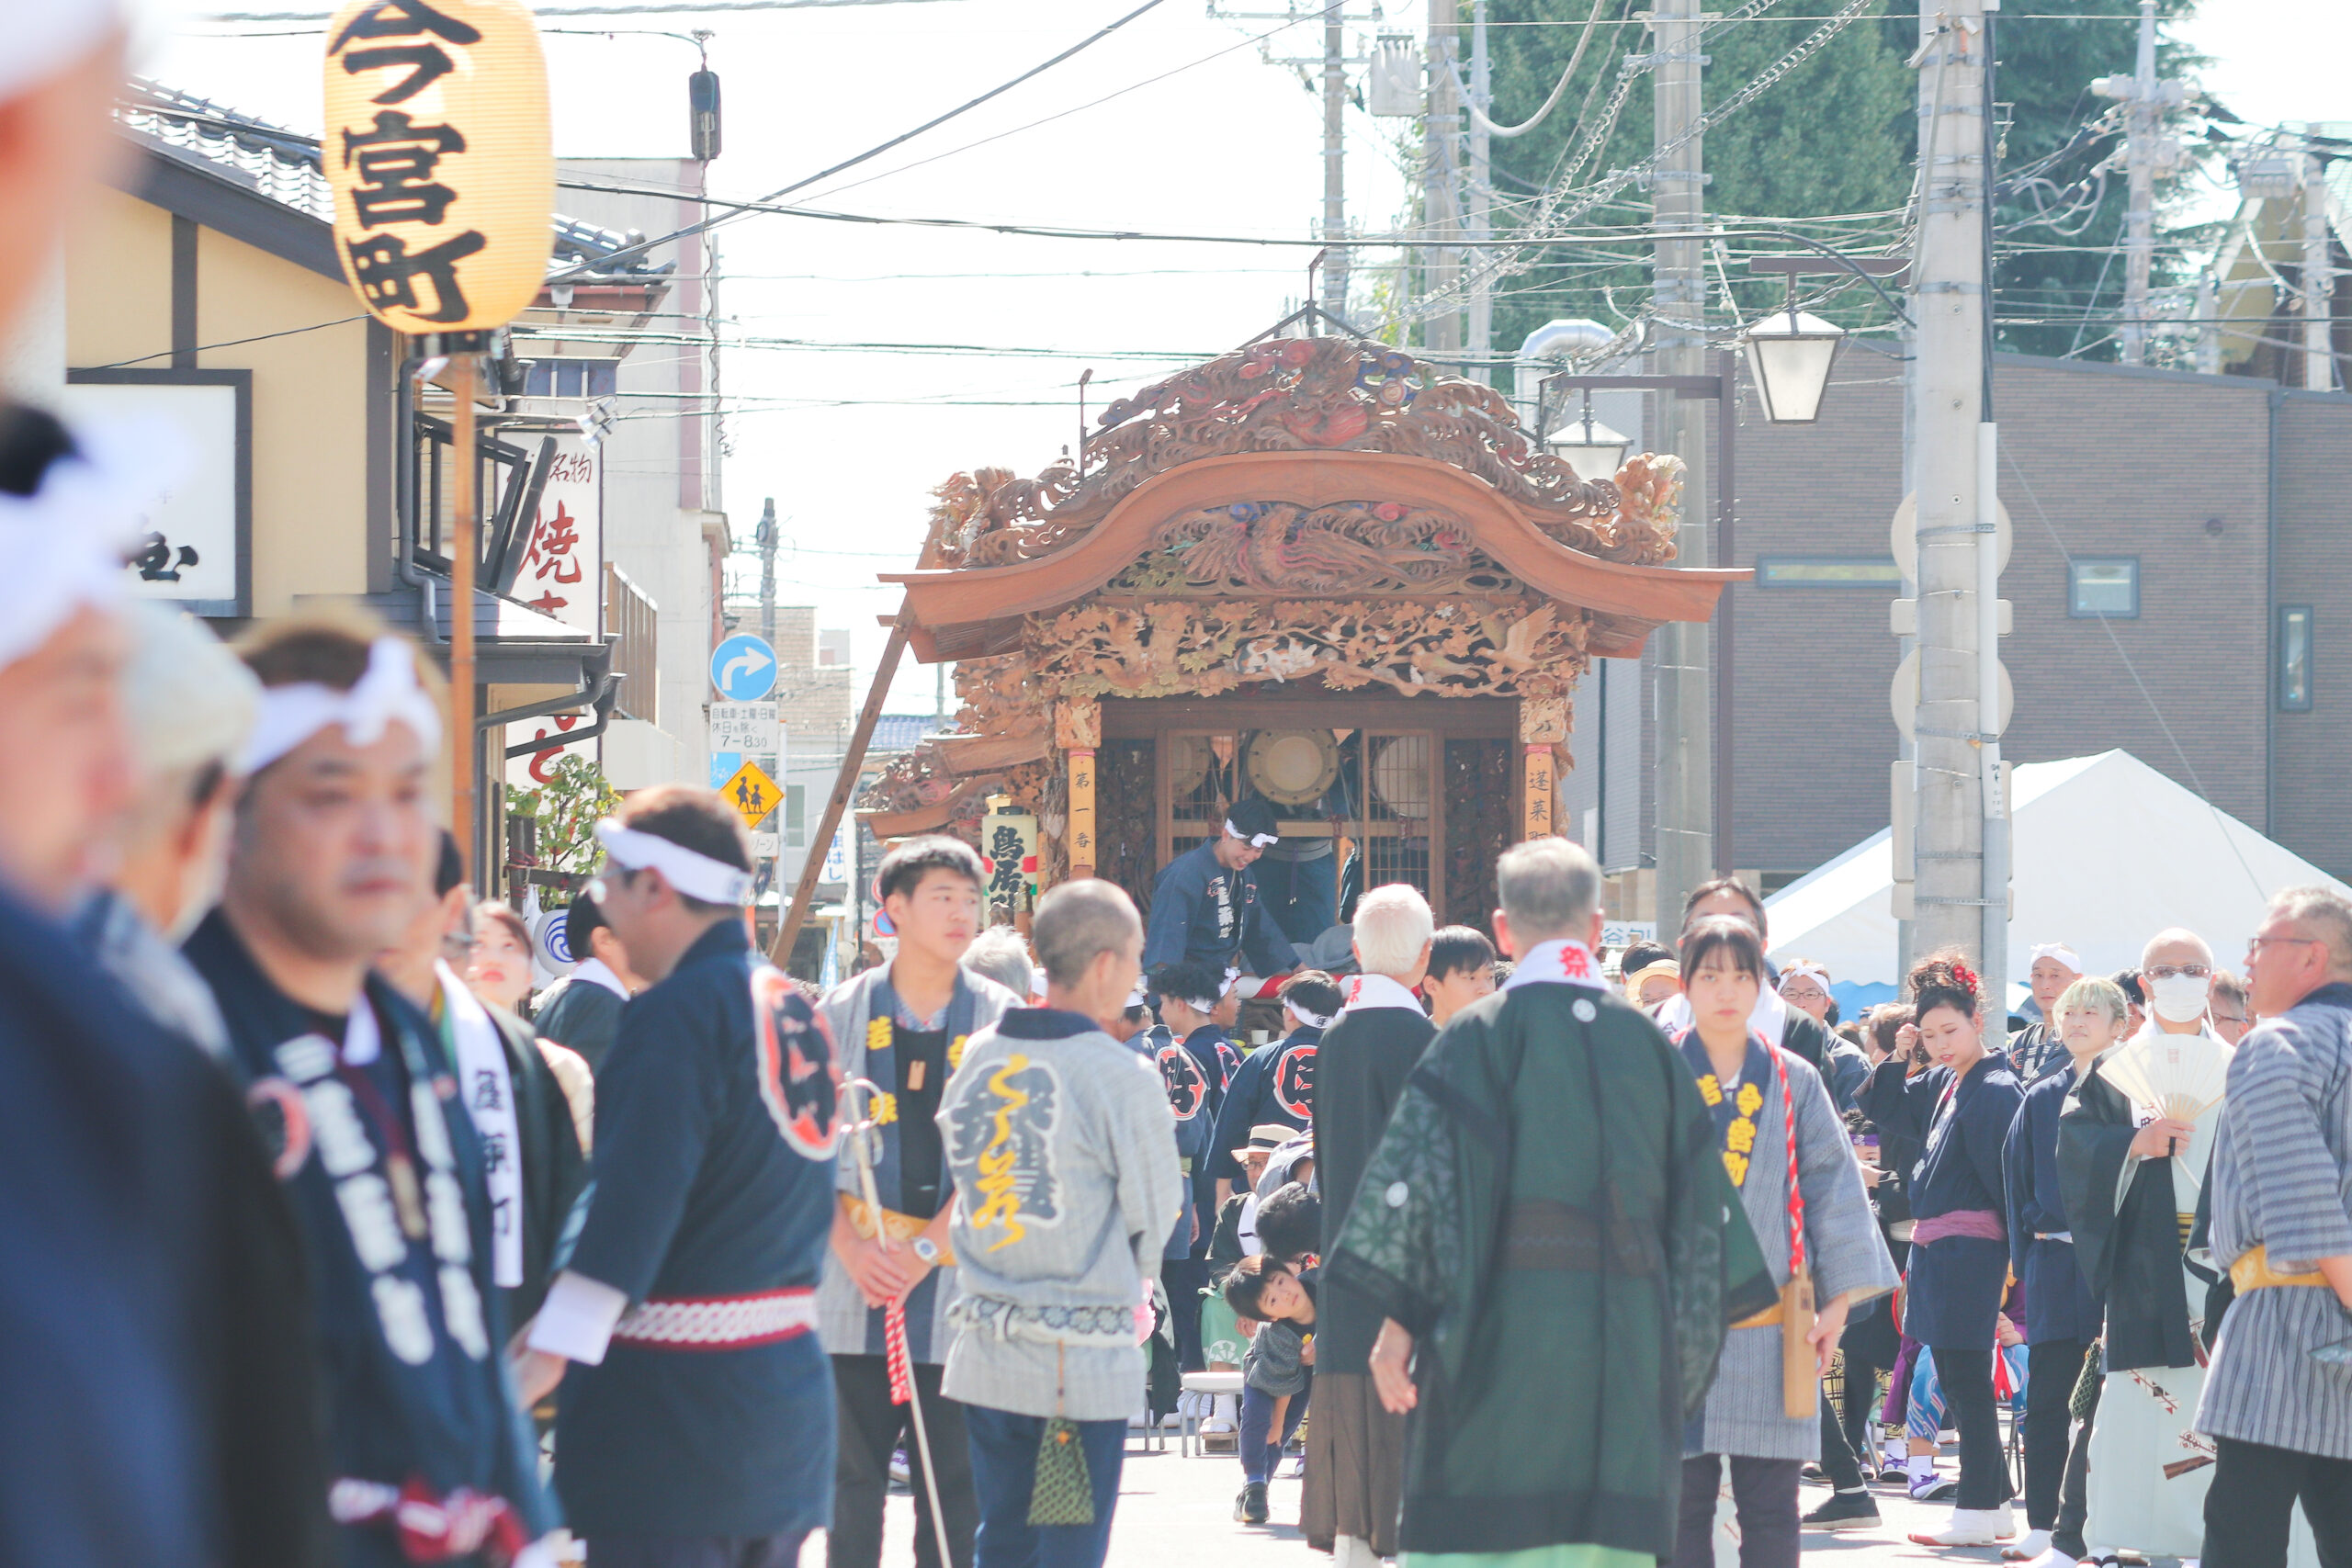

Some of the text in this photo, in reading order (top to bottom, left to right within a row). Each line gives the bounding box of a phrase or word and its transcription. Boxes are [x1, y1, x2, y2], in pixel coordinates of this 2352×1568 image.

[327, 0, 487, 323] 今宮町
[1073, 772, 1091, 849] 第一番
[1560, 945, 1589, 979] 祭
